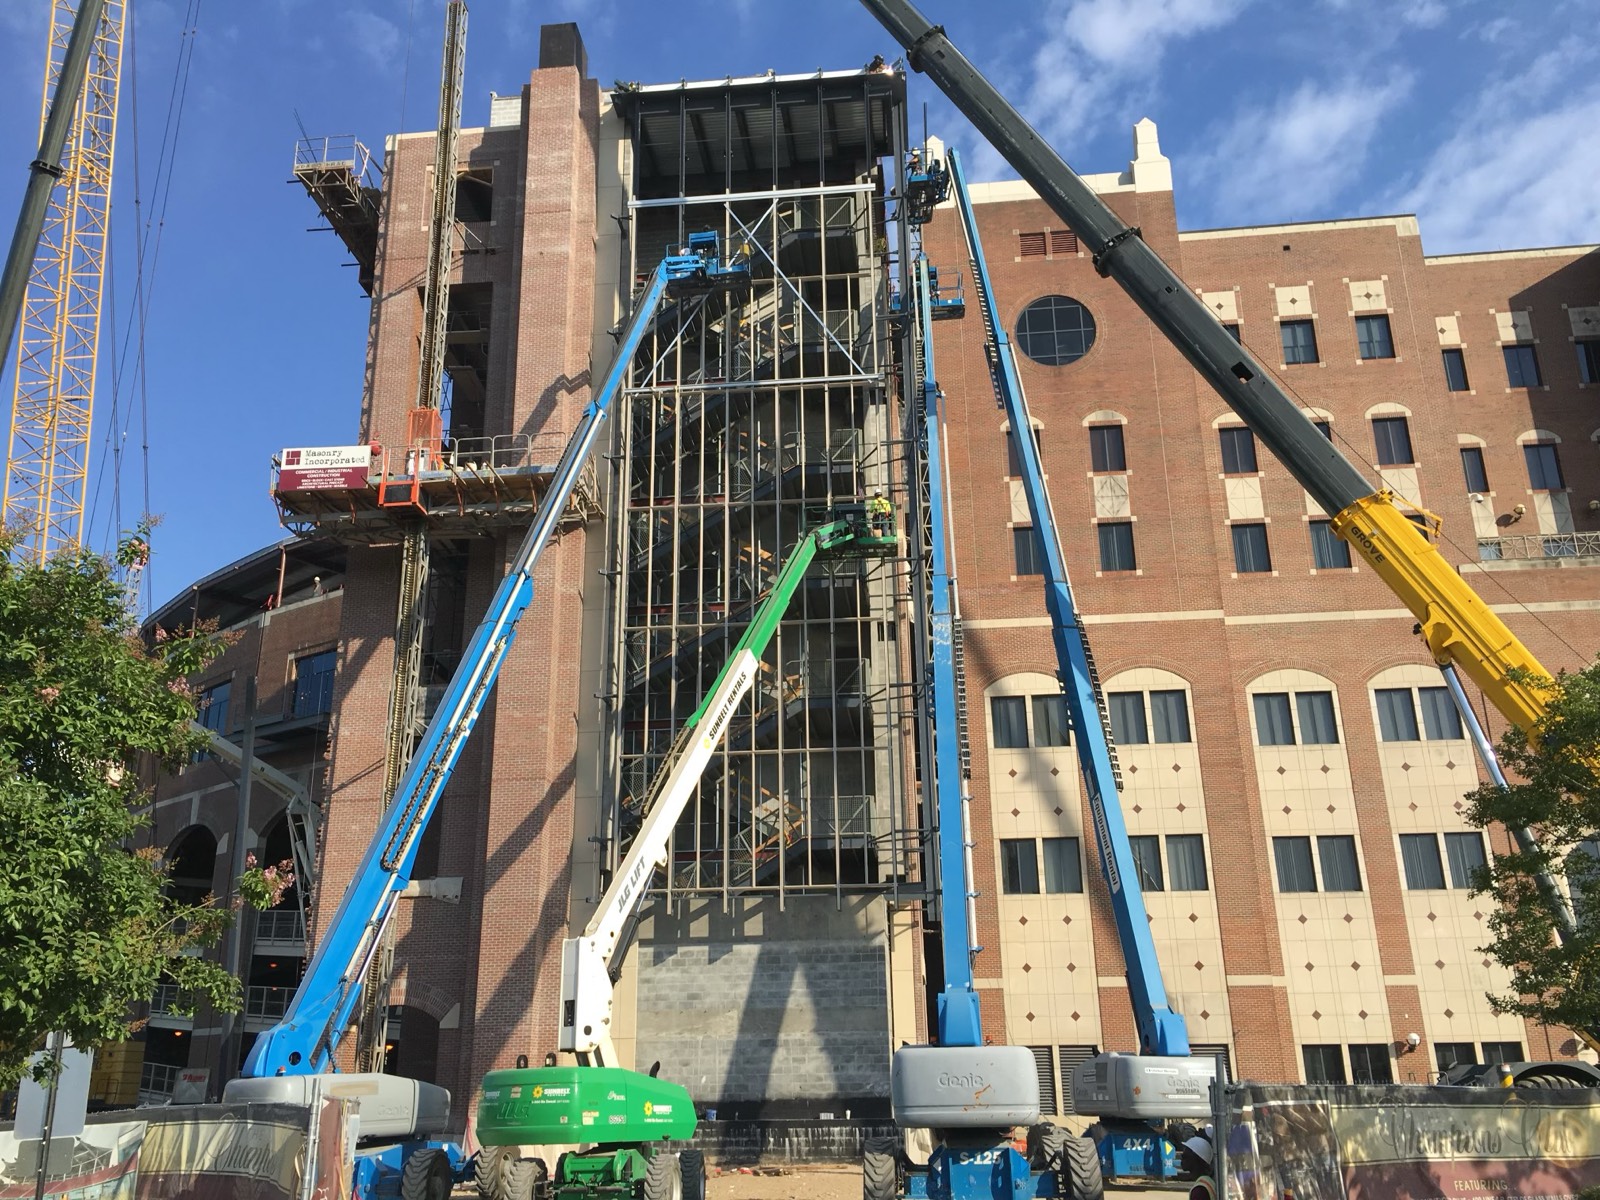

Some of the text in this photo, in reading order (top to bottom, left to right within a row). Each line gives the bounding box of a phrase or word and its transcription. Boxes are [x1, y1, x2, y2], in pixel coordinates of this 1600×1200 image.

[305, 456, 365, 465] Incorporated
[306, 450, 342, 458] Masonry
[1351, 526, 1385, 563] GROVE
[709, 671, 747, 740] SUNBELT RENTALS
[1094, 797, 1118, 886] Equipment Rental
[618, 856, 645, 914] JLG LIFT
[938, 1072, 984, 1090] Genie
[1167, 1076, 1200, 1089] Genie
[1377, 1097, 1502, 1160] Champions
[959, 1151, 1002, 1165] S-125
